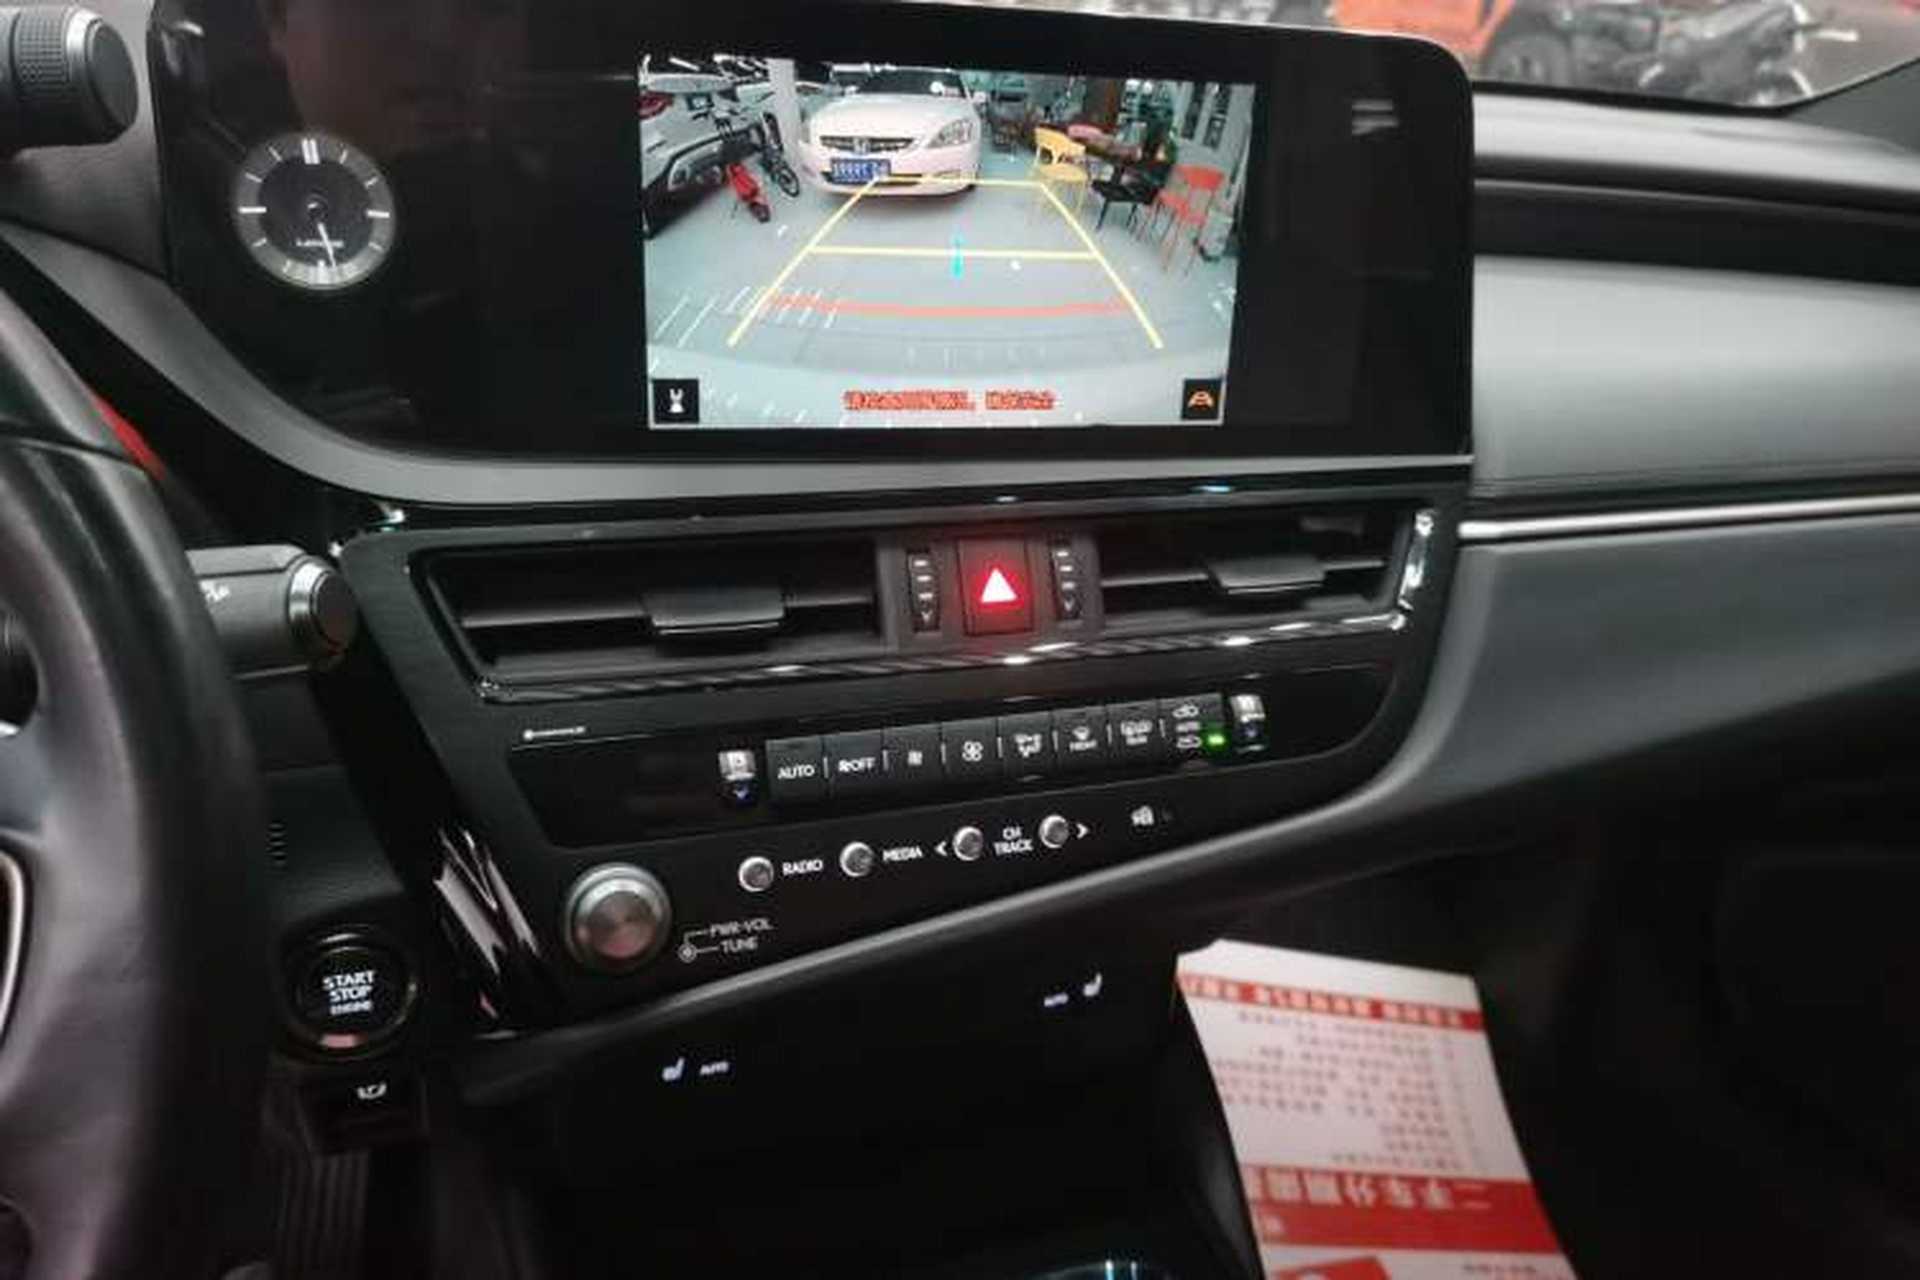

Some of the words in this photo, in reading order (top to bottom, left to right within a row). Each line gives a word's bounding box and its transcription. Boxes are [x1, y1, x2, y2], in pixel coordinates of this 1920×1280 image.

[777, 763, 815, 780] AUTO
[1002, 825, 1022, 841] CH
[882, 845, 923, 862] MEDIA
[993, 838, 1034, 857] TRACK
[782, 858, 824, 876] RADIO
[720, 935, 759, 954] TUNE
[322, 970, 374, 990] START
[329, 985, 373, 1002] STOP
